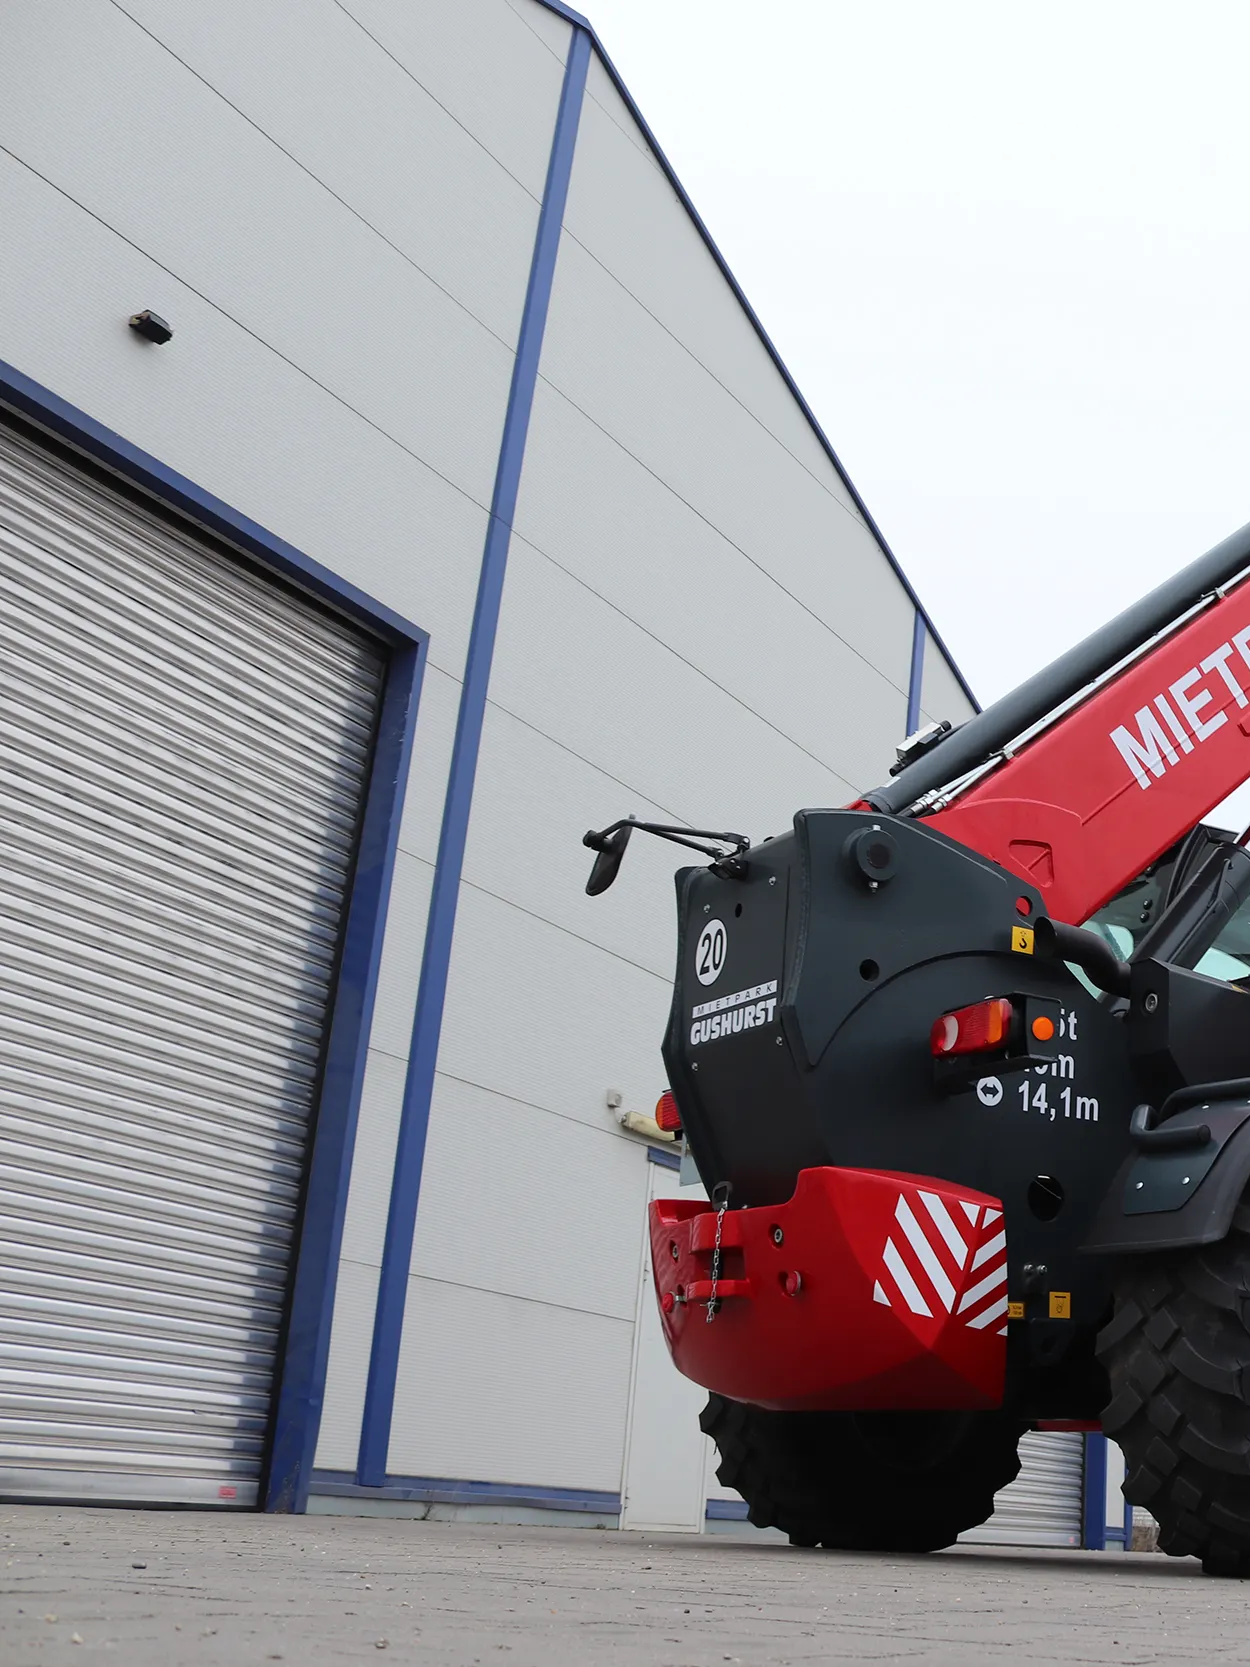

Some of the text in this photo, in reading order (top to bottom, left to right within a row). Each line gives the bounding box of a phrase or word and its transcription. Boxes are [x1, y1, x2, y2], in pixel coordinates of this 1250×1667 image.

[700, 929, 723, 976] 20
[697, 983, 773, 1015] MIETPARK
[690, 998, 777, 1045] GUSHURST
[1018, 1080, 1099, 1121] 14,1m
